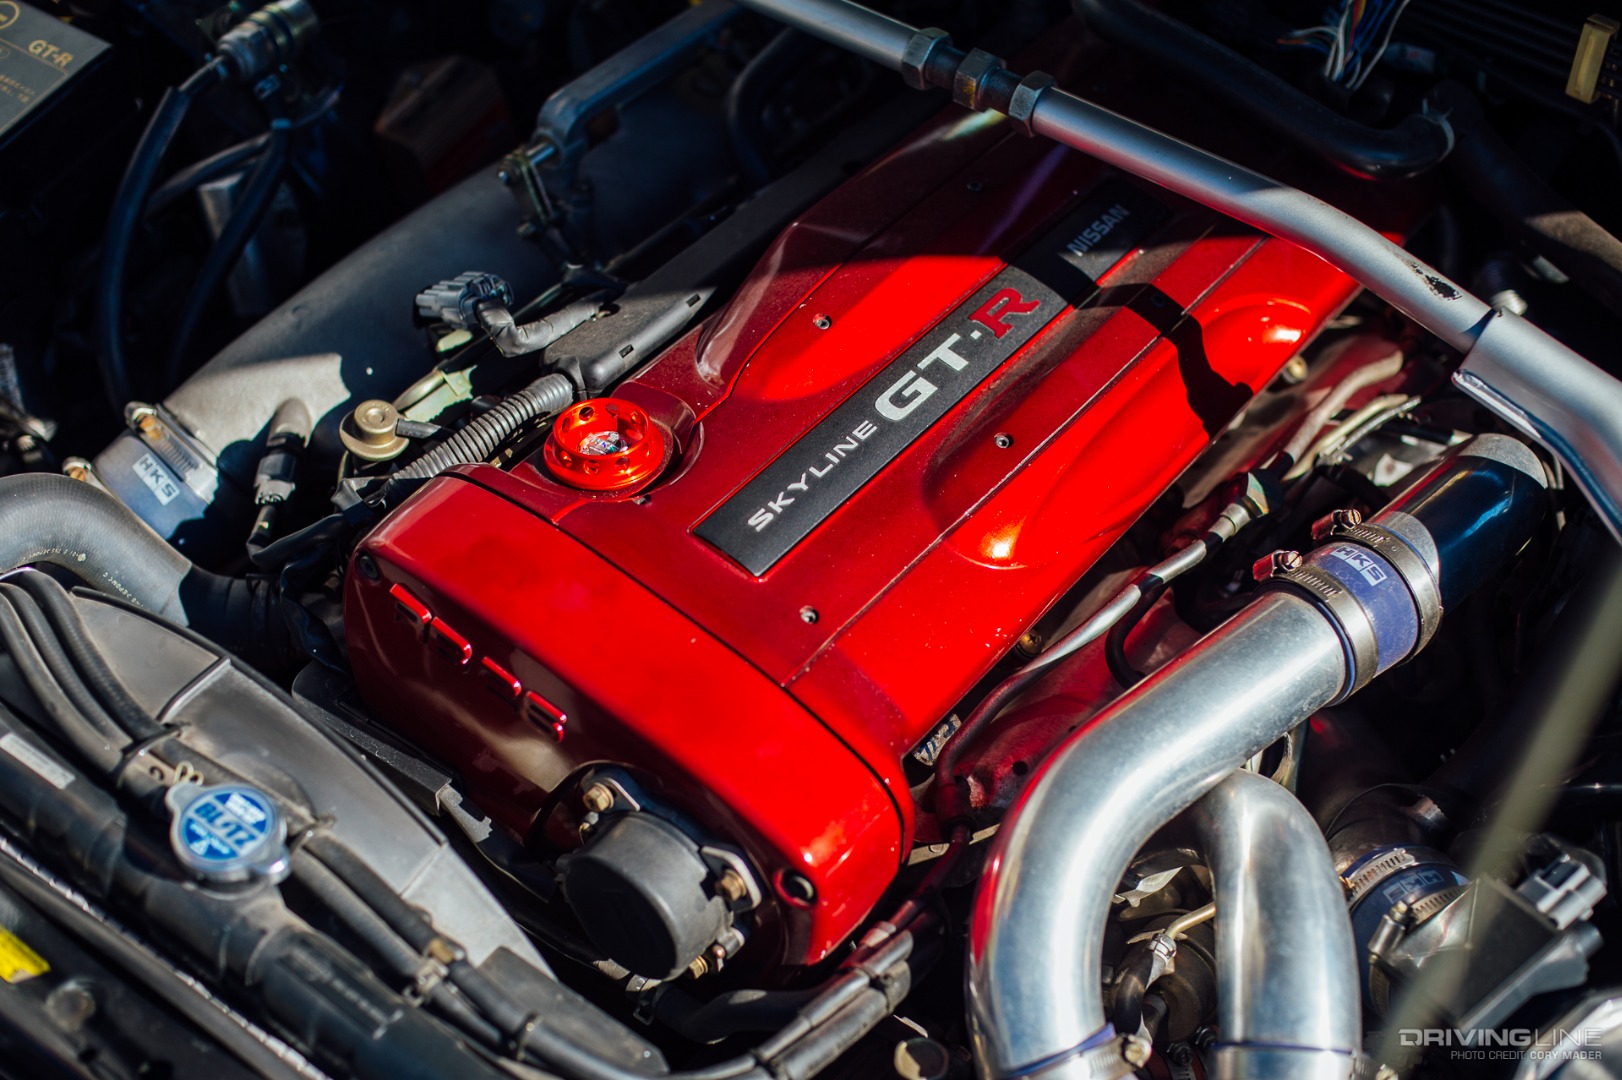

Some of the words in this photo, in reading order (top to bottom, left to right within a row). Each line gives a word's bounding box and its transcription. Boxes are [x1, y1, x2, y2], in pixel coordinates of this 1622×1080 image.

[28, 39, 74, 67] GT-R
[1066, 204, 1130, 257] NISSAN
[136, 455, 179, 502] HKS
[748, 420, 878, 532] SKYLINE
[1331, 546, 1386, 586] HKS
